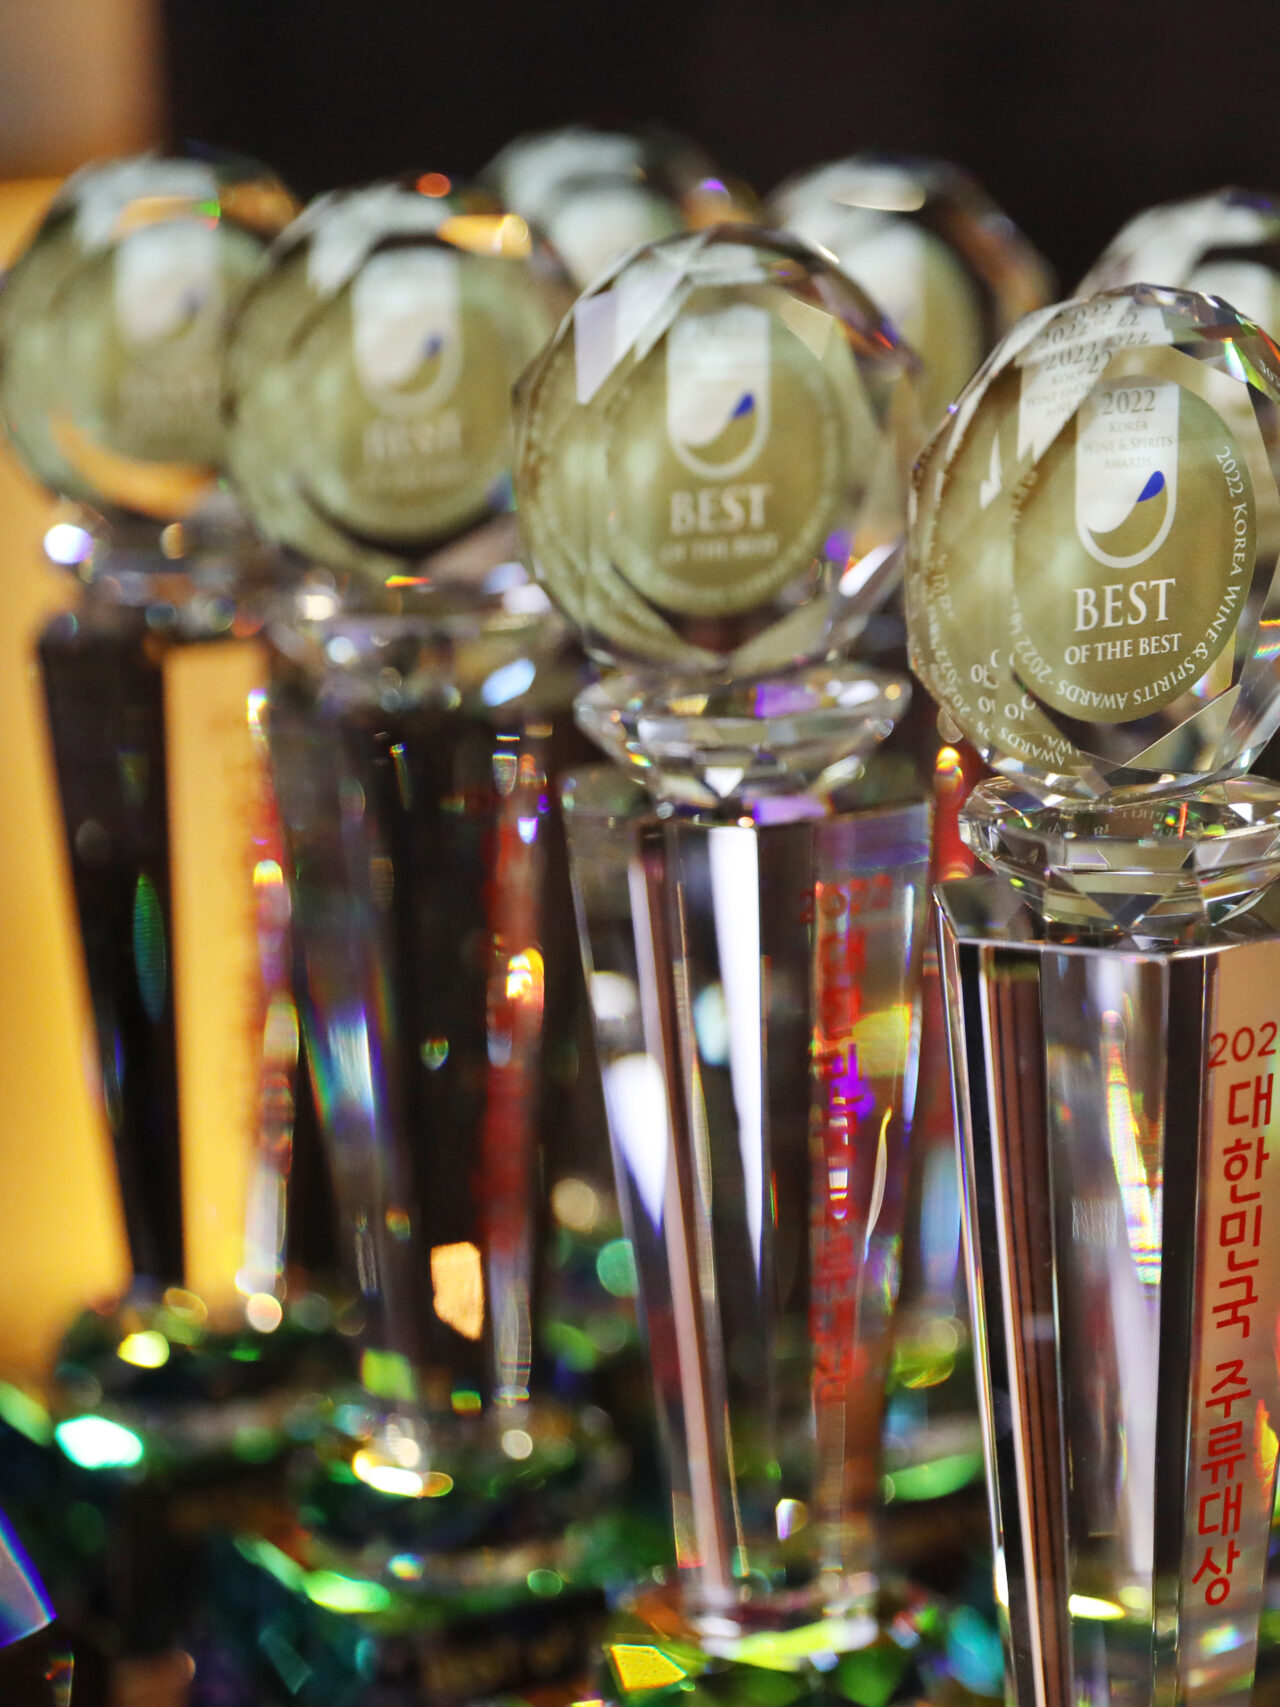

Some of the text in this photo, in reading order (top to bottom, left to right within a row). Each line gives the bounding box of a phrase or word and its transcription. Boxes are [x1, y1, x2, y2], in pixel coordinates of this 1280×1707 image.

[1102, 389, 1156, 415] 2022
[1109, 420, 1149, 433] KOREA
[1130, 435, 1174, 449] SPIRITS
[1104, 456, 1152, 470] AWARDS
[1215, 446, 1244, 498] 2022
[671, 484, 773, 534] BEST
[1230, 502, 1248, 576] KOREA
[1073, 578, 1176, 632] BEST
[1205, 586, 1241, 643] WINE
[1064, 633, 1182, 665] OF THE BEST
[1192, 642, 1209, 660] &
[1056, 680, 1129, 711] AWARDS
[1133, 657, 1196, 705] SPIRITS
[1213, 1072, 1275, 1339] 대한민국
[1191, 1358, 1252, 1606] 주류대상
